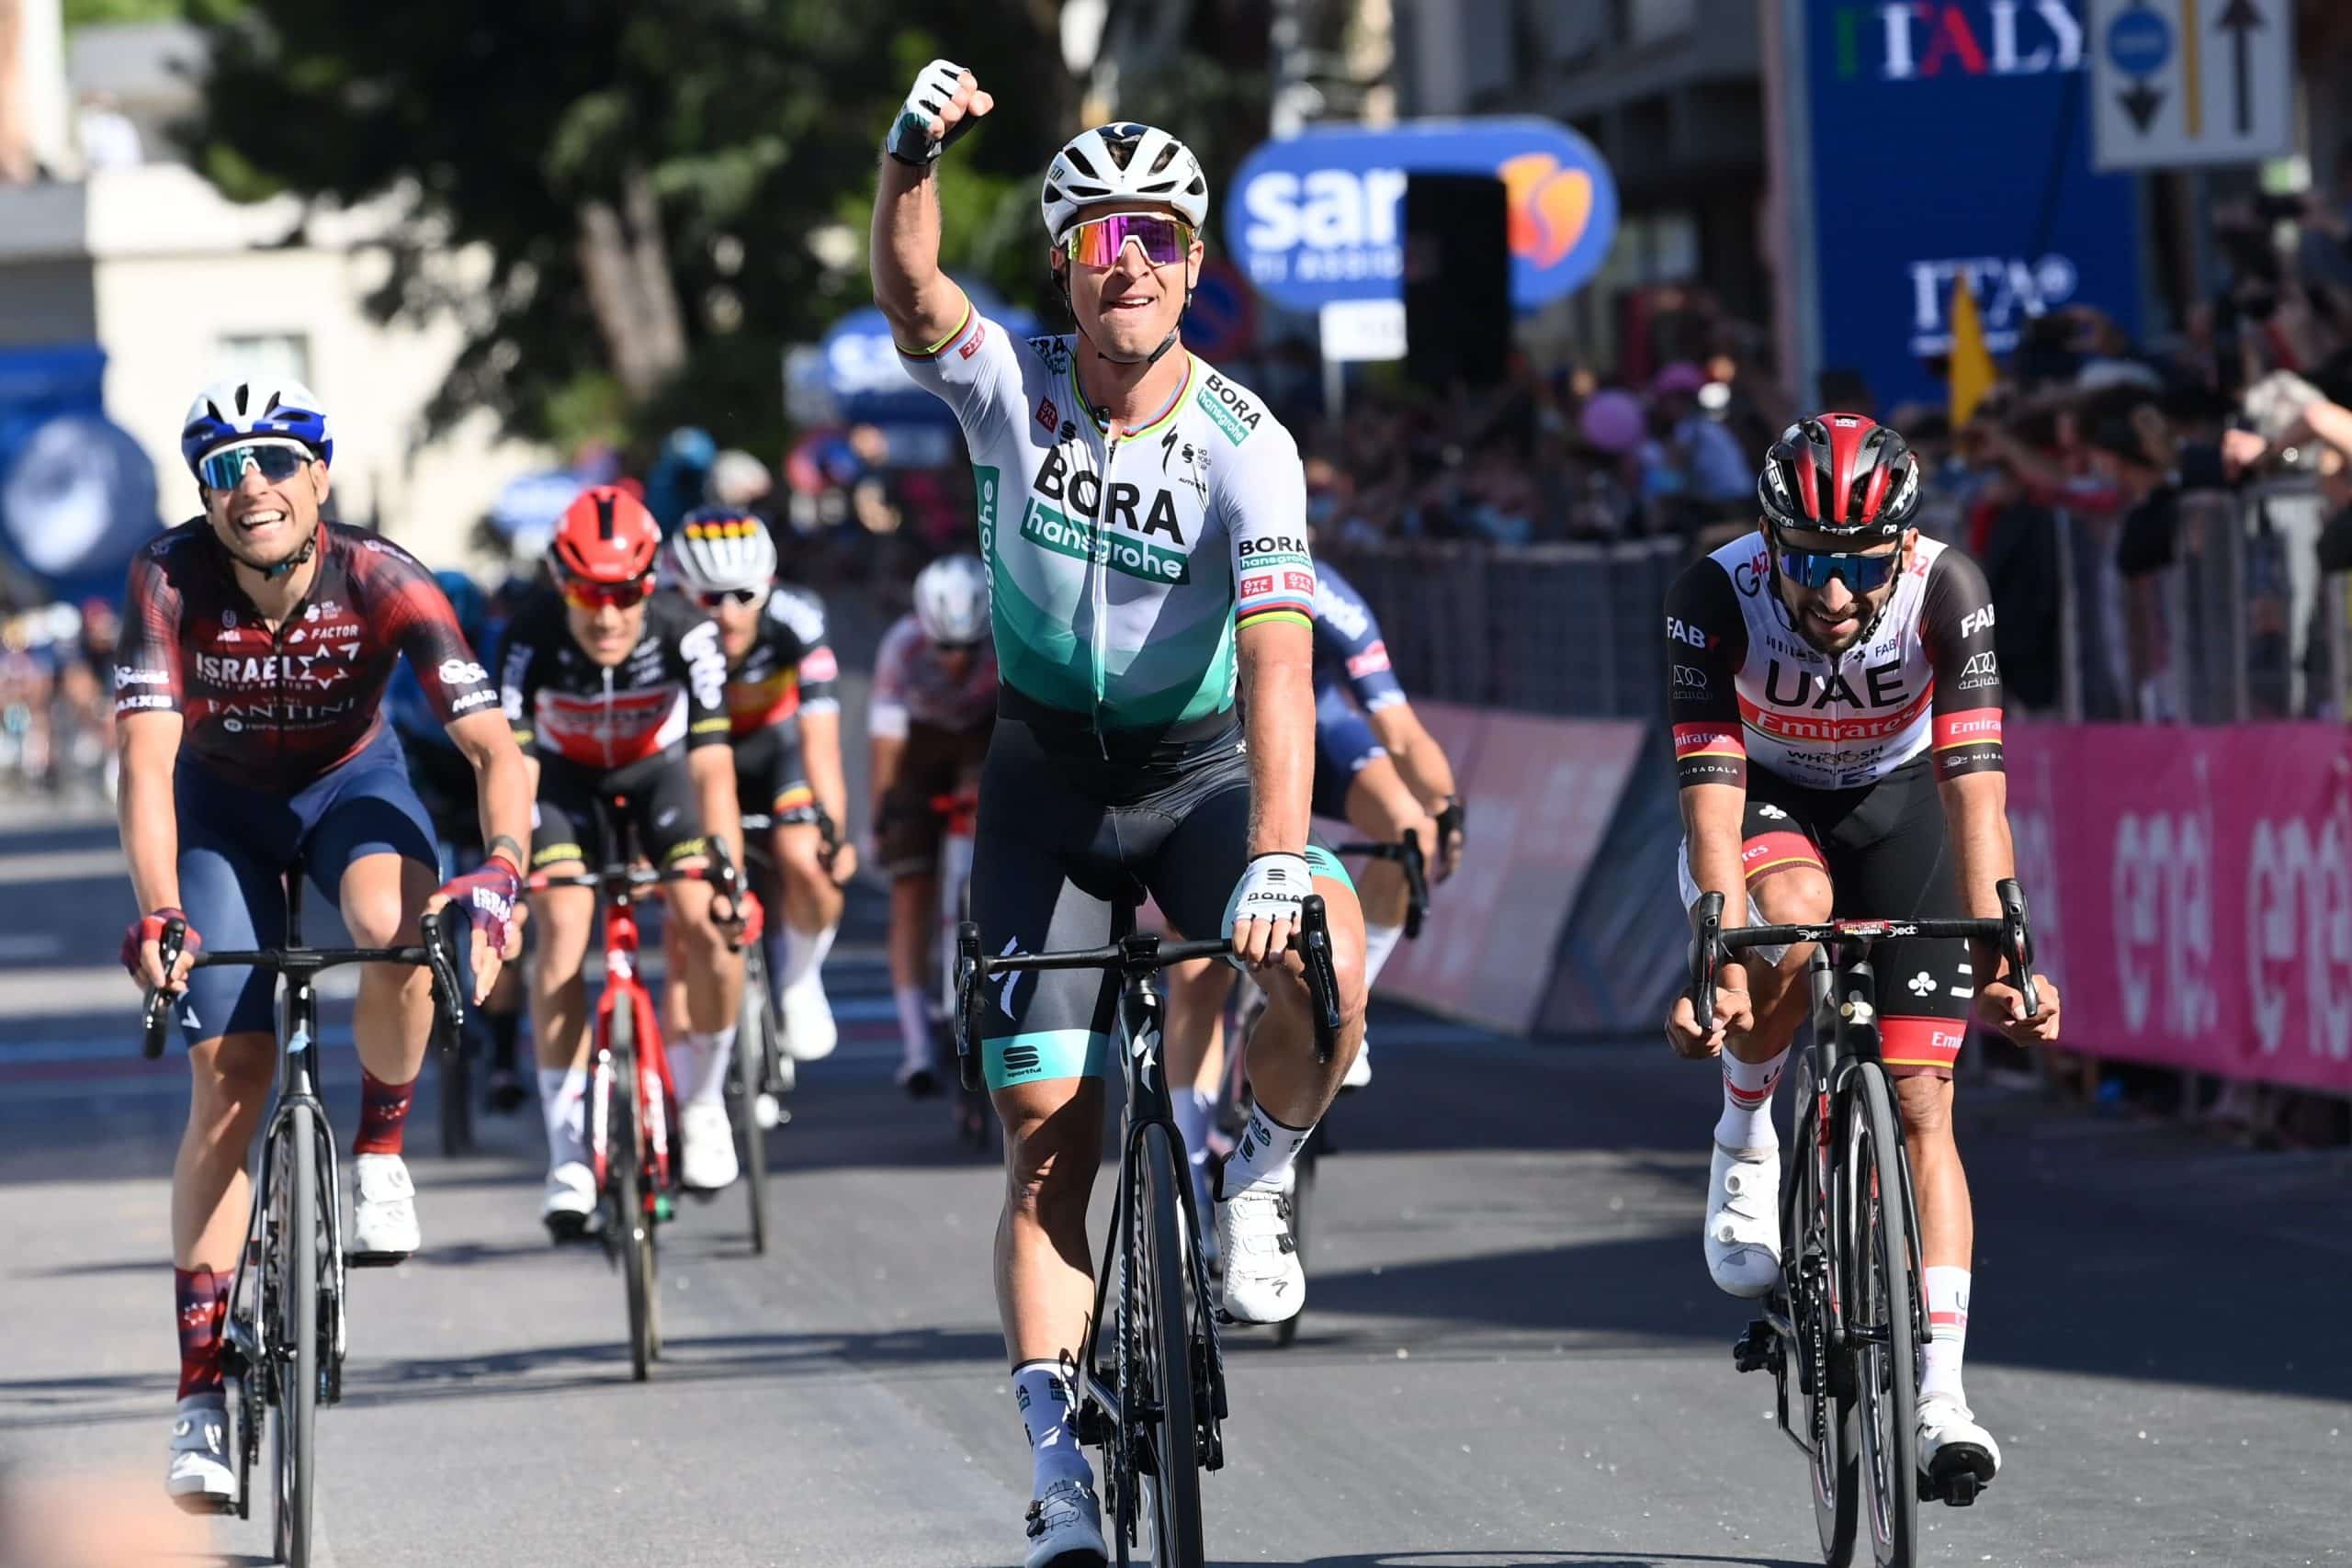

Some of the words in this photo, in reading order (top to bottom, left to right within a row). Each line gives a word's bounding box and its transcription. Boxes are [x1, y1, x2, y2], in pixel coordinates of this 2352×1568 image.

[1198, 389, 1245, 442] hansgrohe
[1204, 374, 1261, 430] BORA
[1033, 445, 1185, 546] BORA
[1026, 499, 1183, 580] hansgrohe
[1238, 536, 1308, 557] BORA
[311, 625, 359, 640] FACTOR
[1667, 616, 1706, 649] FAB
[1874, 638, 1896, 658] FAB
[196, 651, 297, 683] ISRAEL
[1764, 658, 1910, 710] UAE
[1951, 716, 2002, 736] Emira
[1248, 892, 1303, 904] BORA
[1006, 1067, 1043, 1078] sportful
